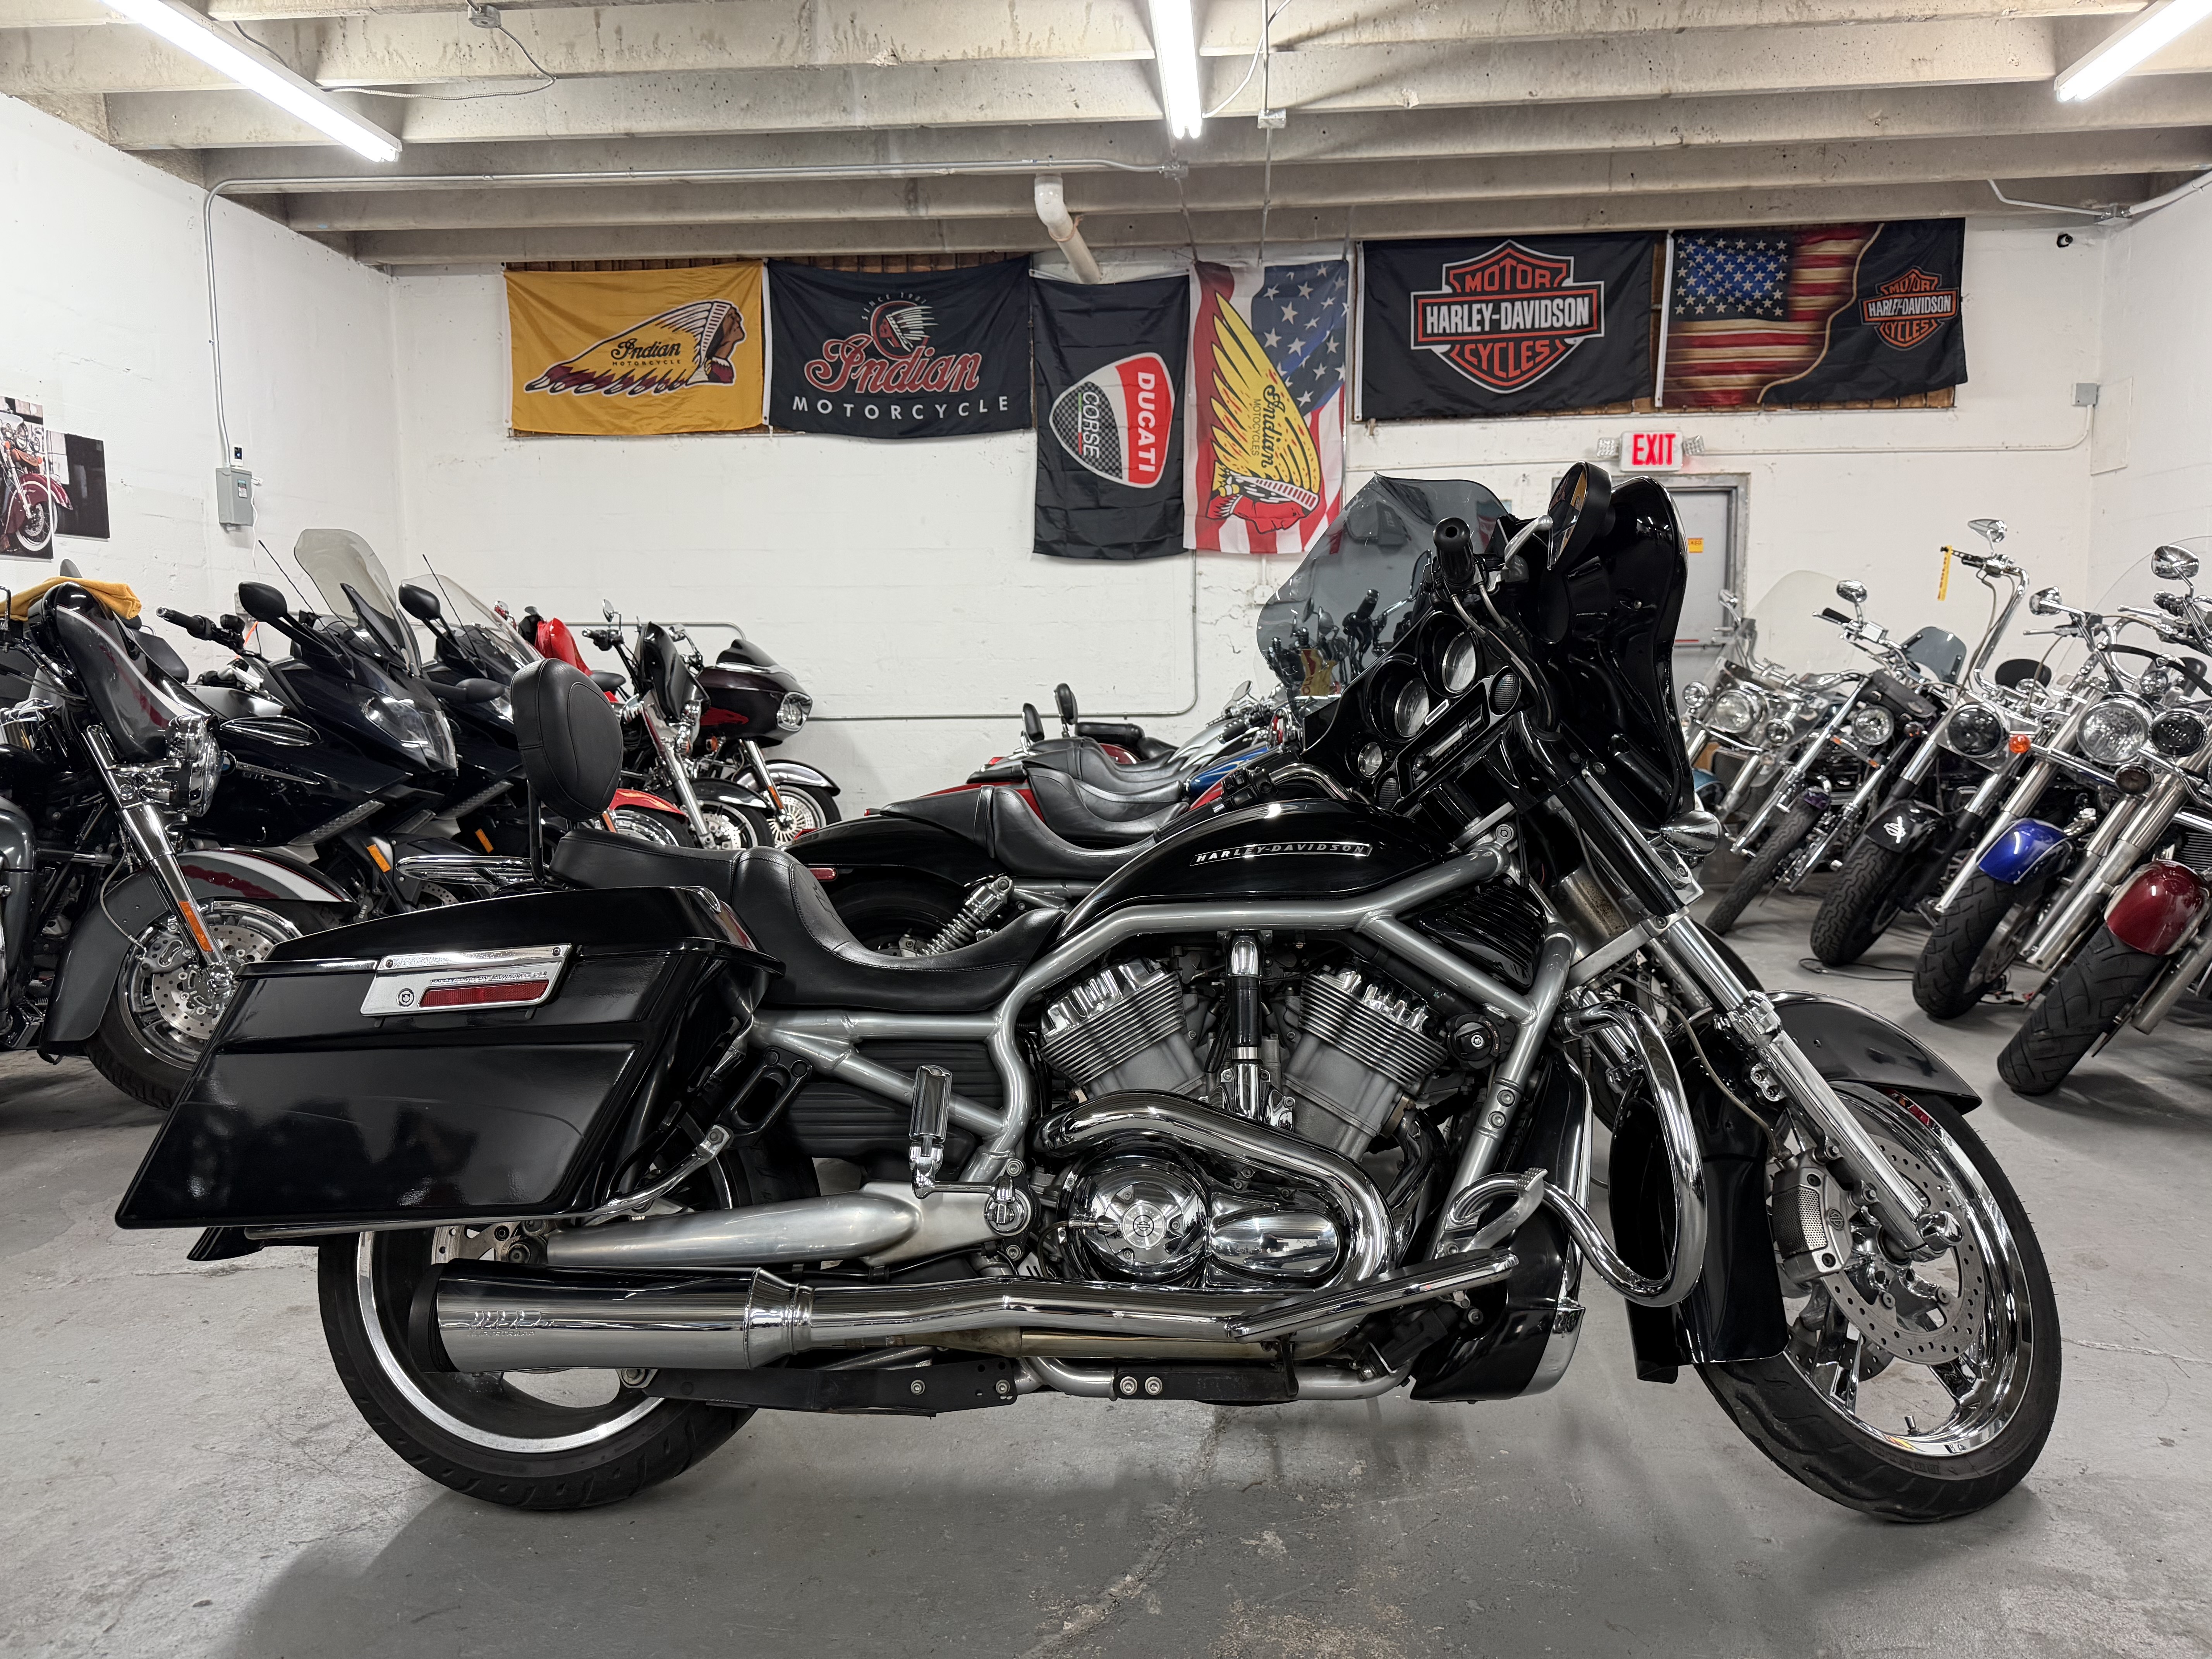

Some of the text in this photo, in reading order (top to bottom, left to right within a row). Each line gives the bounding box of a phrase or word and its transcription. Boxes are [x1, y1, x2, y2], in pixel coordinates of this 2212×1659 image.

[1465, 258, 1551, 293] MOTOR
[1889, 273, 1930, 294] MOTOR
[861, 291, 927, 321] SINCE 1901
[1426, 297, 1589, 334] HARLEY-DAVIDSON
[1869, 295, 1951, 317] HARLEY-DAVIDSON
[1886, 320, 1930, 342] CYCLES
[611, 338, 681, 360] Indian
[612, 359, 682, 367] MOTORCYCLE
[804, 333, 983, 393] Indian
[1464, 339, 1550, 378] CYCLES
[792, 396, 1009, 420] MOTORCYCLE
[1137, 372, 1156, 472] DUCATI
[1082, 391, 1100, 459] CORSE
[1252, 398, 1261, 457] MOTOCYCLES
[1261, 384, 1286, 469] Indian
[1632, 433, 1676, 465] EXIT
[1196, 843, 1365, 862] HARLEY-DAVIDSON
[358, 904, 368, 919] BMW
